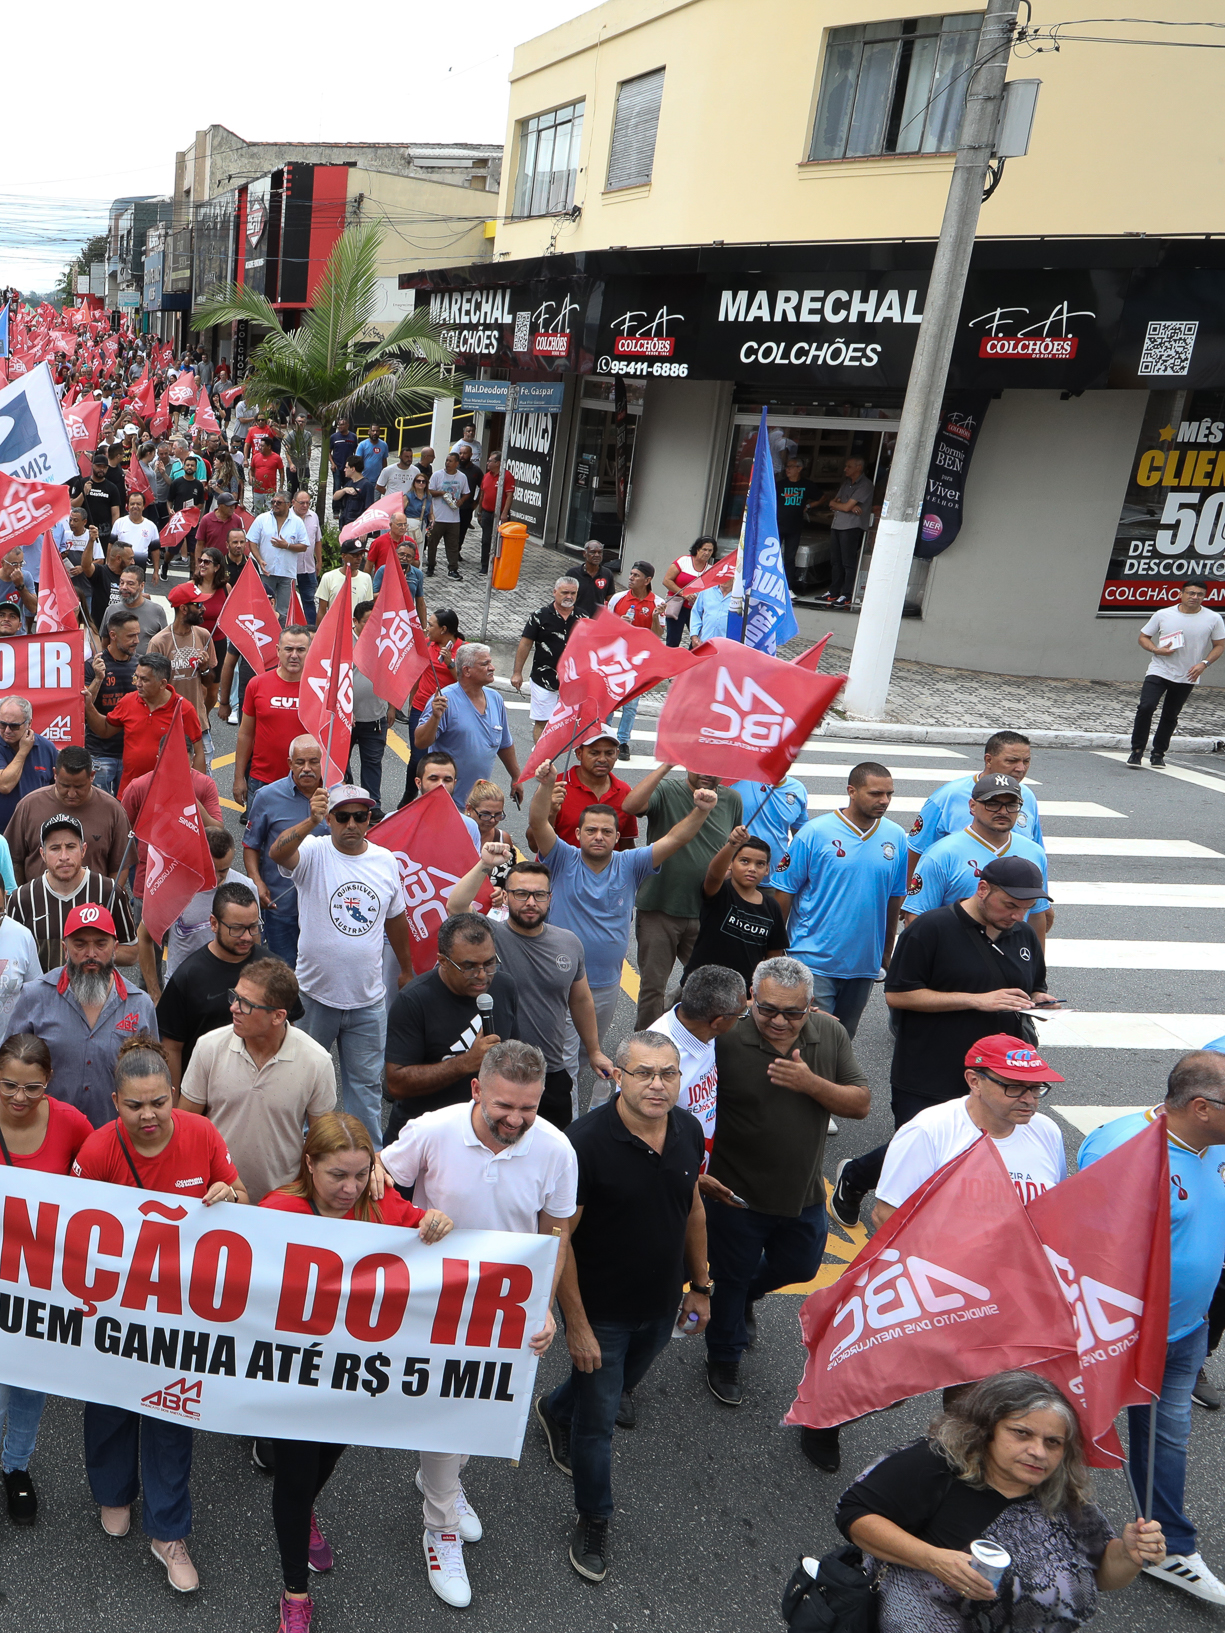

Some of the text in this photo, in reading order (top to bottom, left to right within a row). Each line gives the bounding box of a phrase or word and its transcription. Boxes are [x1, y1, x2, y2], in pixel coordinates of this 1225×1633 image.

[428, 289, 513, 324] MARECHAL
[717, 289, 924, 324] MARECHAL
[535, 333, 568, 351] COLCHÕES
[618, 337, 671, 352] COLCHÕES
[985, 337, 1072, 355] COLCHÕES
[739, 337, 882, 368] COLCHÕES
[610, 360, 689, 378] 95411-6886
[520, 386, 555, 397] Fe. Gaspar
[1176, 417, 1225, 444] MÊS
[506, 458, 542, 486] COBRIMOS
[523, 489, 542, 508] OFERTA
[1128, 540, 1155, 557] DE
[28, 641, 72, 689] IR
[105, 676, 116, 687] 39
[39, 727, 72, 739] ABC
[994, 774, 1010, 787] NY
[336, 883, 377, 901] QUIKSILVER
[79, 907, 100, 924] W
[334, 916, 374, 934] AUSTRALIA
[274, 1242, 411, 1342] DO
[429, 1257, 533, 1350] IR
[94, 1315, 237, 1378] GANHA
[244, 1339, 324, 1387] ATÉ
[330, 1351, 392, 1398] R$
[401, 1355, 431, 1398] 5
[439, 1358, 515, 1402] MIL
[140, 1389, 201, 1418] ABC
